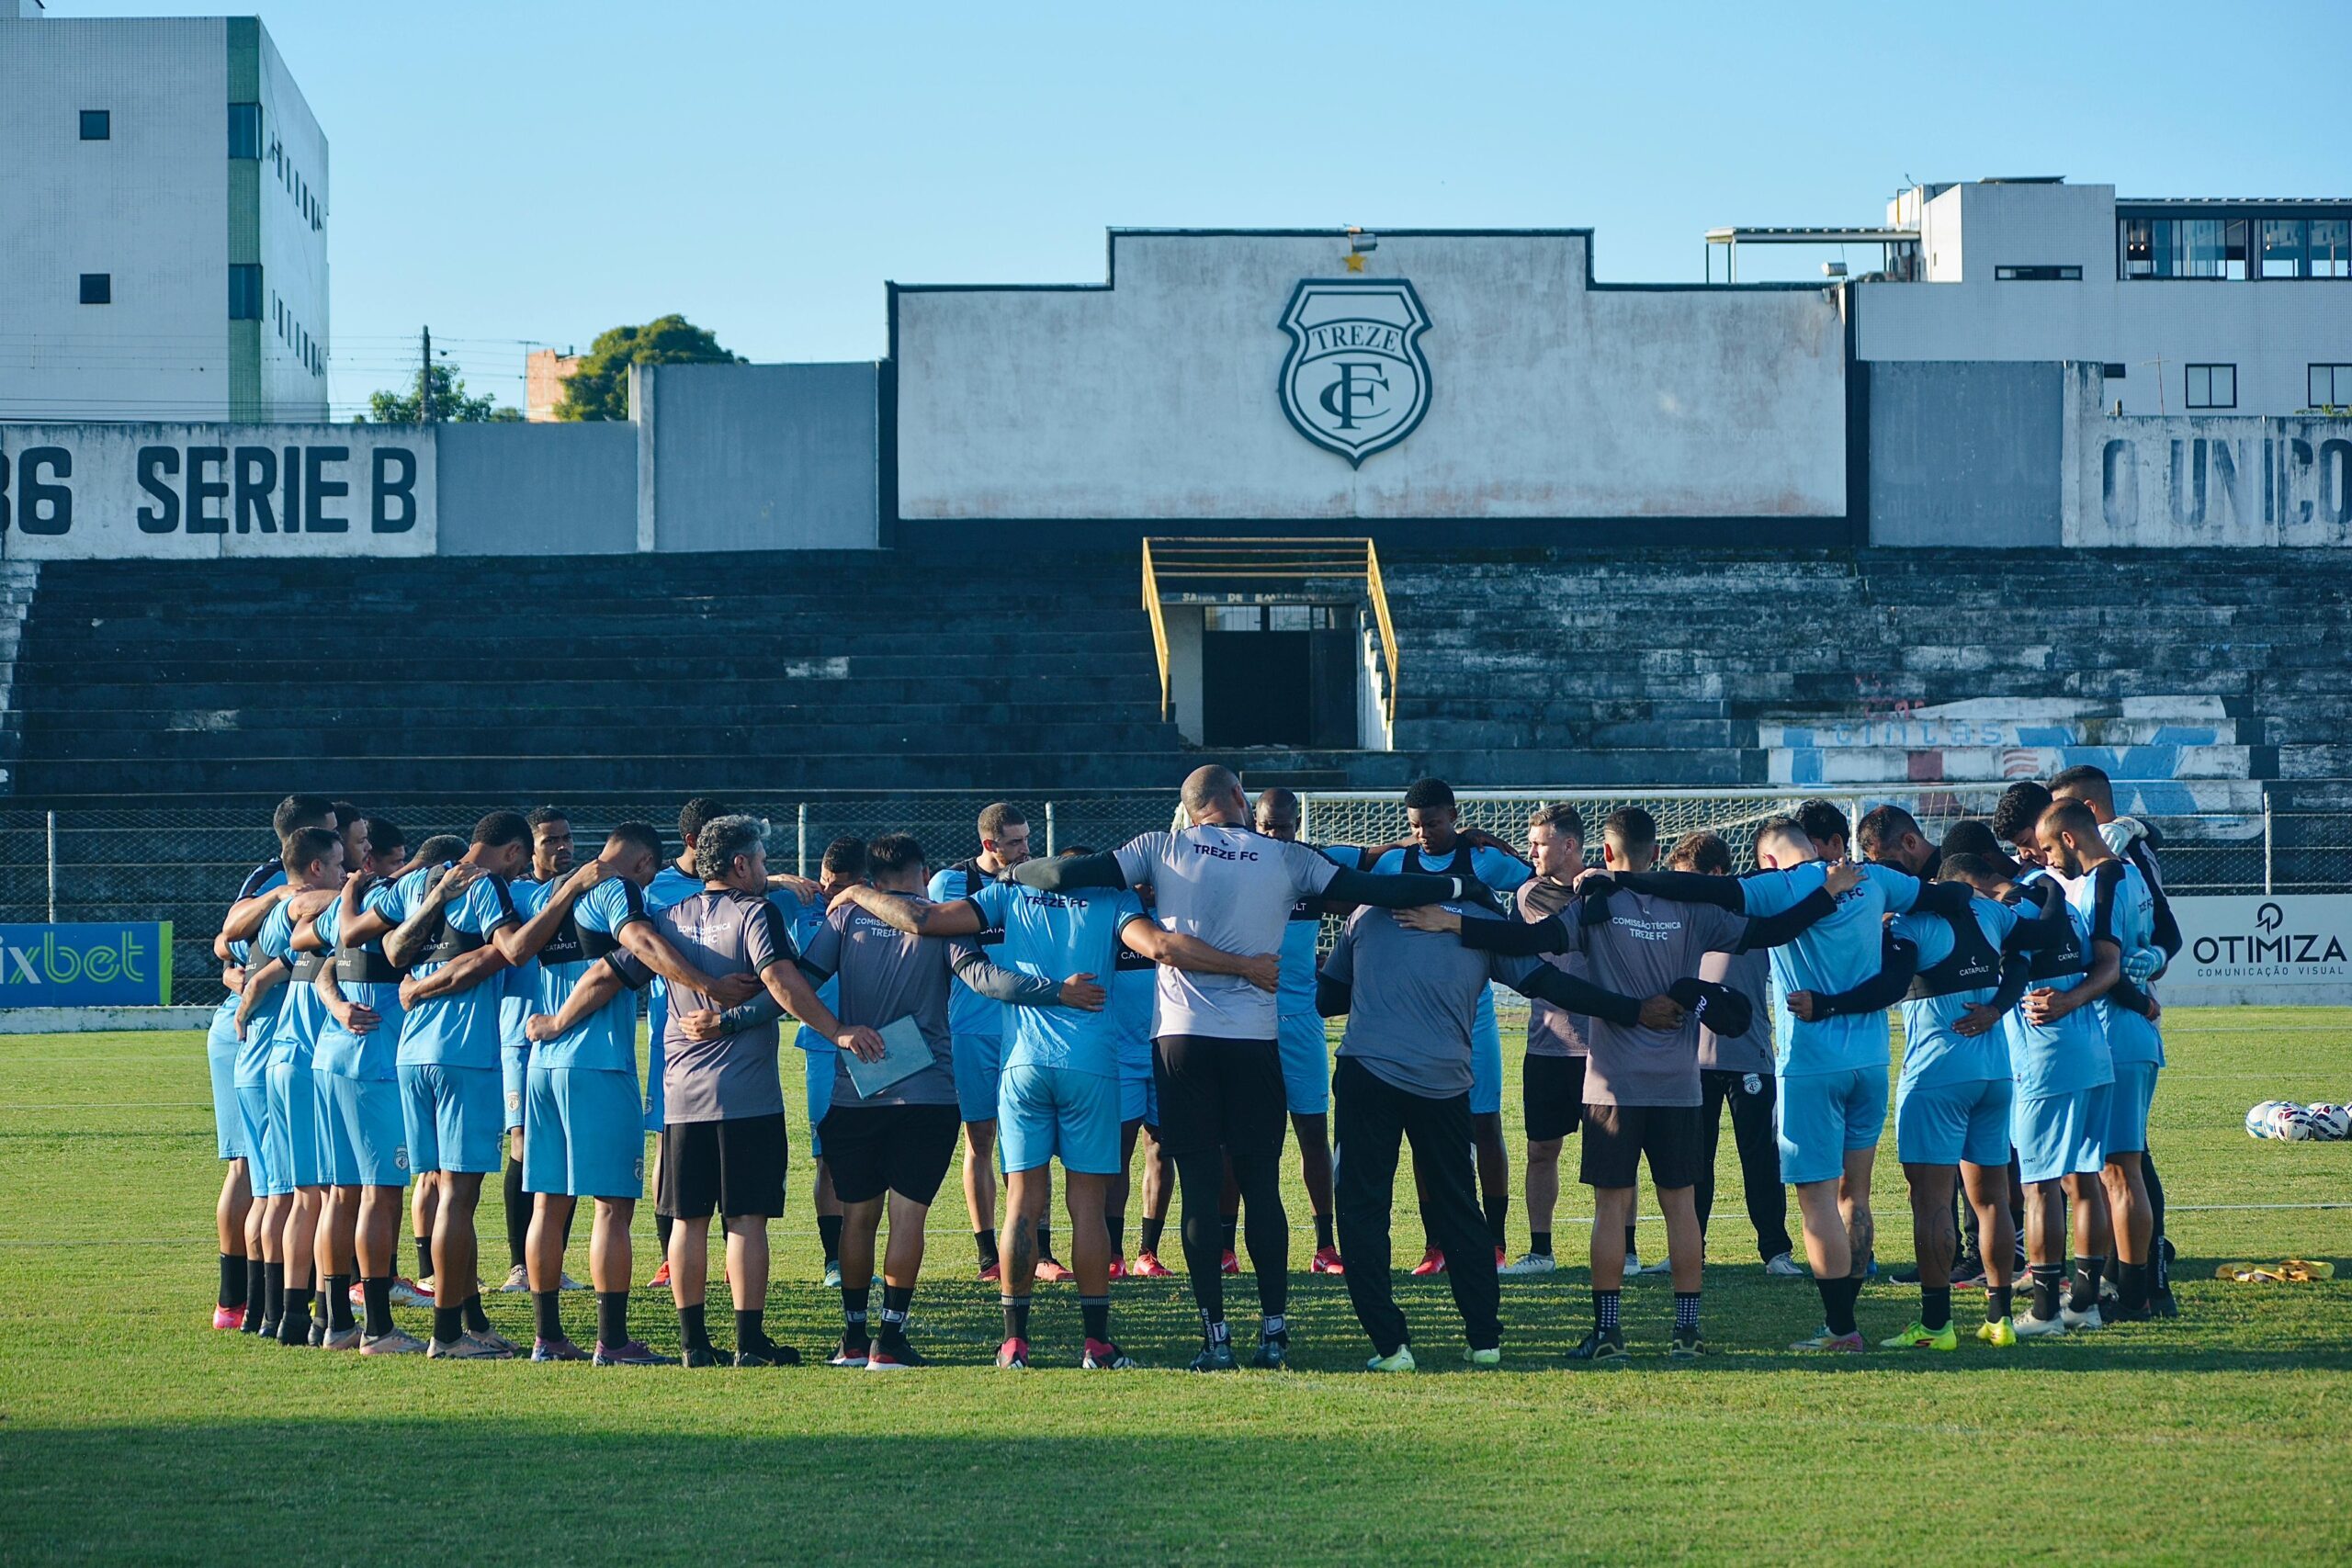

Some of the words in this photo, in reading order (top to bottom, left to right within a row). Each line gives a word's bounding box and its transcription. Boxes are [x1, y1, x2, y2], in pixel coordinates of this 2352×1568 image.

[1312, 324, 1399, 353] TREZE
[136, 446, 349, 535] SERIE
[371, 446, 417, 535] B
[1227, 592, 1243, 603] DE
[1193, 844, 1236, 861] TREZE
[1239, 851, 1259, 862] FC
[1025, 896, 1067, 908] TREZE
[1069, 898, 1089, 908] FC
[871, 927, 897, 938] TREZE
[1629, 928, 1655, 941] TREZE
[1656, 931, 1668, 941] FC
[545, 941, 578, 952] CATAPULT
[2192, 934, 2348, 964] OTIMIZA
[1959, 964, 1990, 976] CATAPULT
[2197, 964, 2290, 977] COMUNICAÇÃO
[2298, 965, 2345, 976] VISUAL
